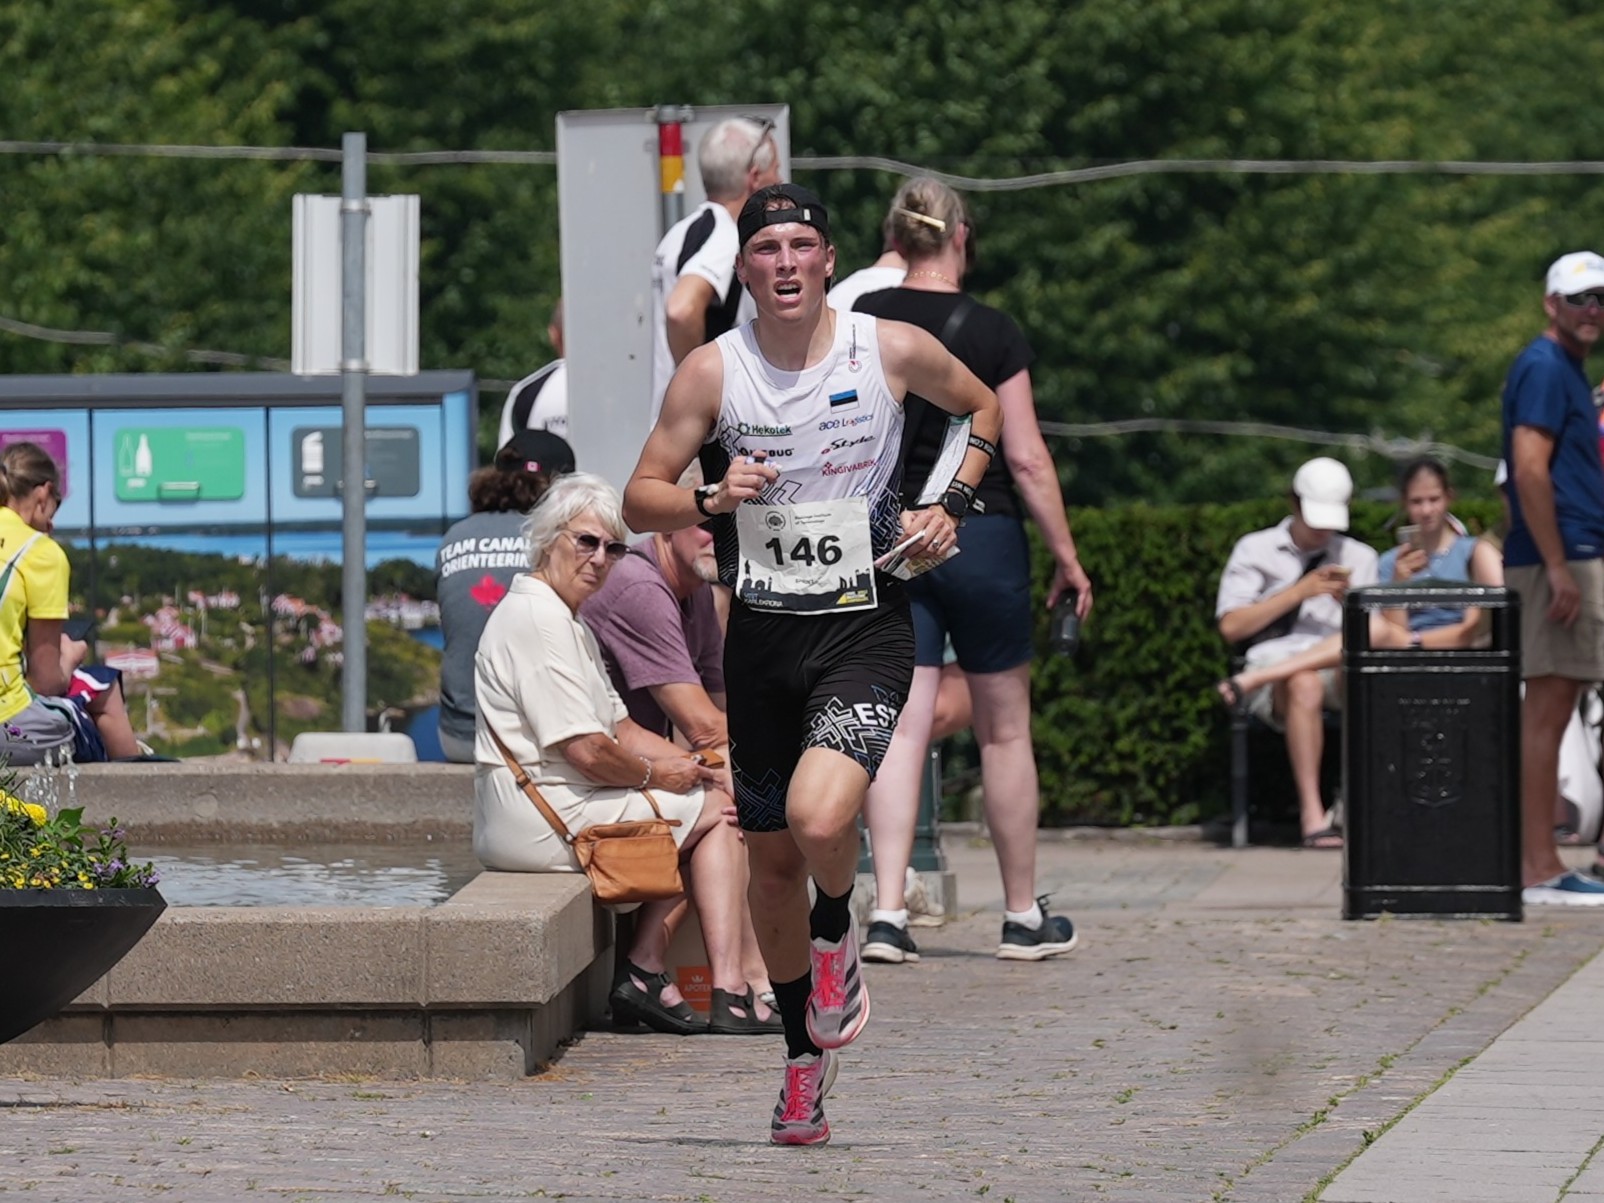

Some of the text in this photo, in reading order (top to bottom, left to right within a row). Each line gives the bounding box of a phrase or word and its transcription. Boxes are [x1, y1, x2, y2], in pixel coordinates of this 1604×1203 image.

[752, 424, 792, 435] Hekotek
[818, 419, 840, 431] ace
[440, 538, 477, 563] TEAM
[765, 535, 843, 567] 146
[853, 702, 898, 728] EST
